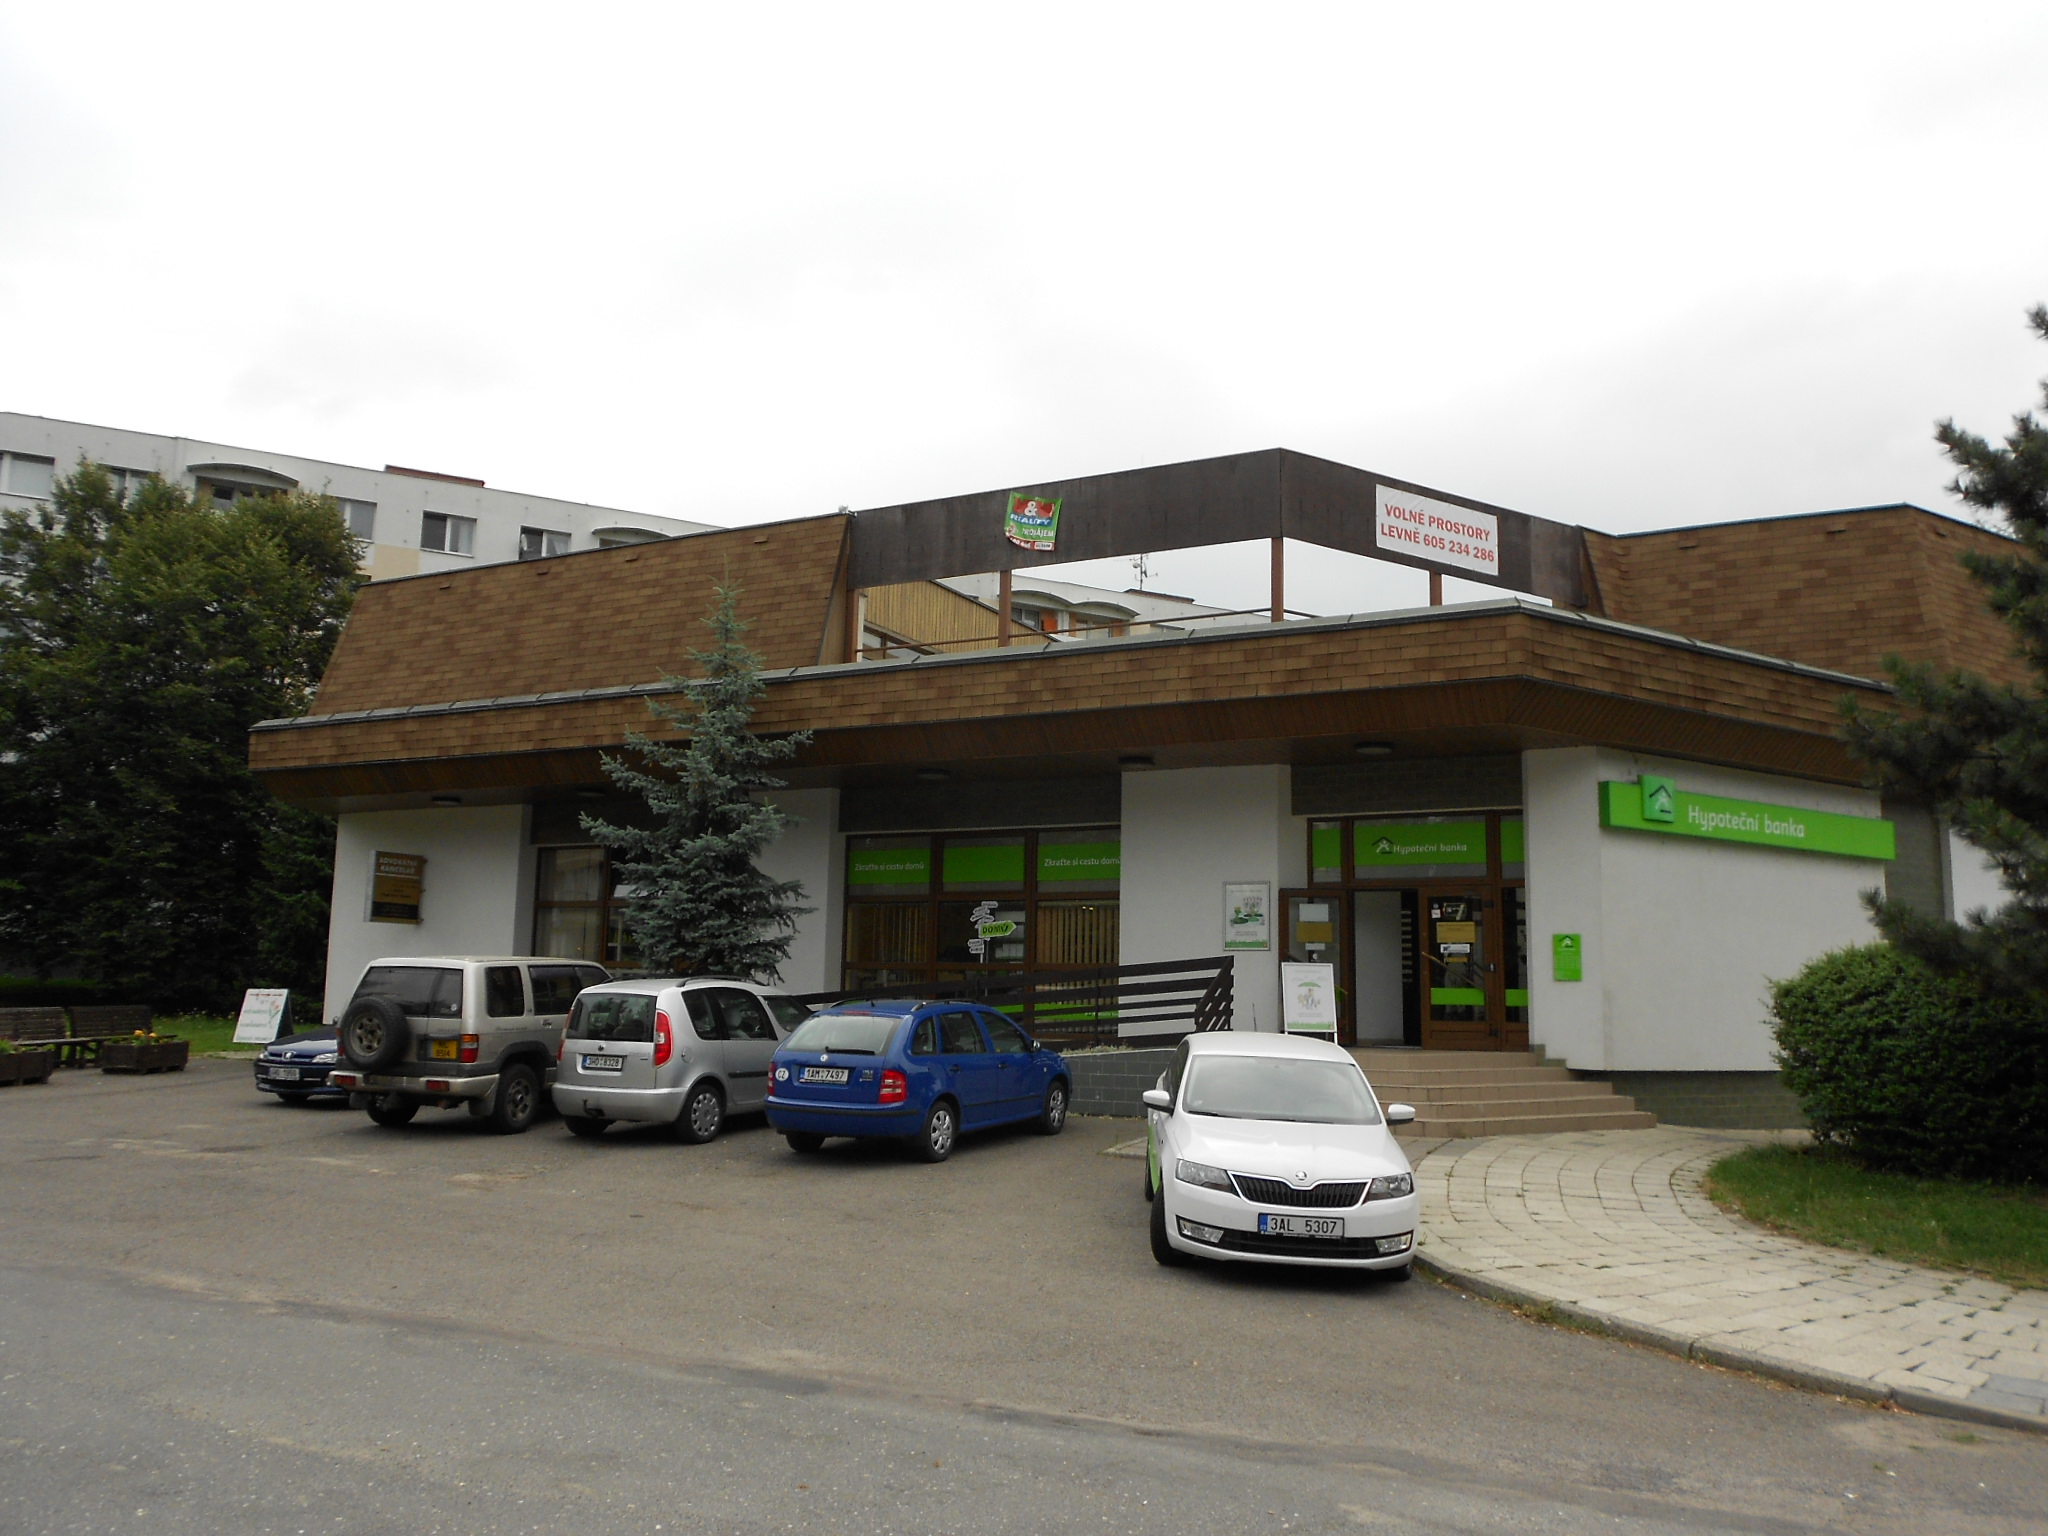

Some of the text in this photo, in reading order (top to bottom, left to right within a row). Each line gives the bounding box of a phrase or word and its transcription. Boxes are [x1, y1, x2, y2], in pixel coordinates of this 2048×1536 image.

[1385, 503, 1490, 542] VOLNÉ PROSTORY
[1380, 522, 1495, 562] LEVNĚ 605 234 286
[1688, 804, 1805, 838] Hypoteční banka
[1393, 842, 1467, 855] Hypoteční banka
[603, 1057, 620, 1067] 8328
[807, 1069, 845, 1079] 1AM 7497
[1270, 1217, 1337, 1234] 3AL 5307
